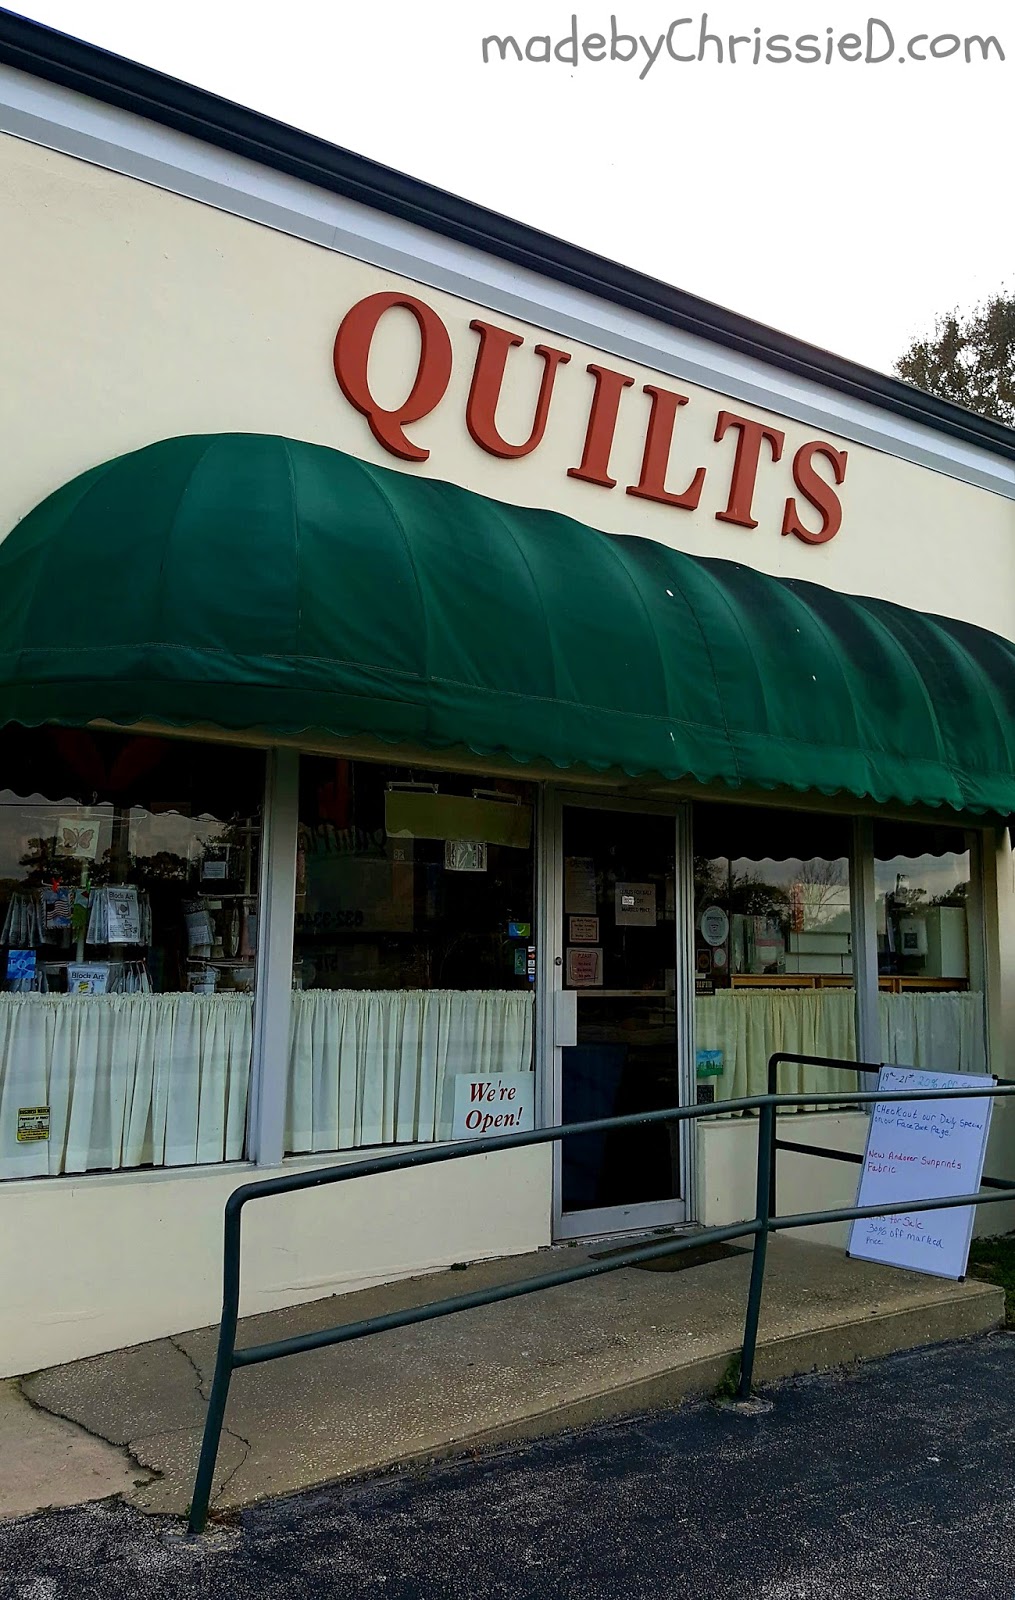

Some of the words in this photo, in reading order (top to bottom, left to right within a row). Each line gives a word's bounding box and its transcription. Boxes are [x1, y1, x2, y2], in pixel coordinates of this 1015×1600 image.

[333, 291, 848, 545] QUILTS
[71, 971, 91, 979] Block
[918, 1075, 938, 1088] 20%
[470, 1080, 516, 1102] We're
[465, 1106, 523, 1133] Open!
[940, 1113, 957, 1130] Daily
[867, 1161, 896, 1174] Fabric
[868, 1150, 885, 1159] New
[888, 1151, 919, 1162] Andover
[921, 1156, 962, 1170] Sunprints
[902, 1216, 924, 1230] Sale
[866, 1224, 887, 1236] 30%
[889, 1228, 904, 1238] off
[906, 1232, 944, 1249] marked
